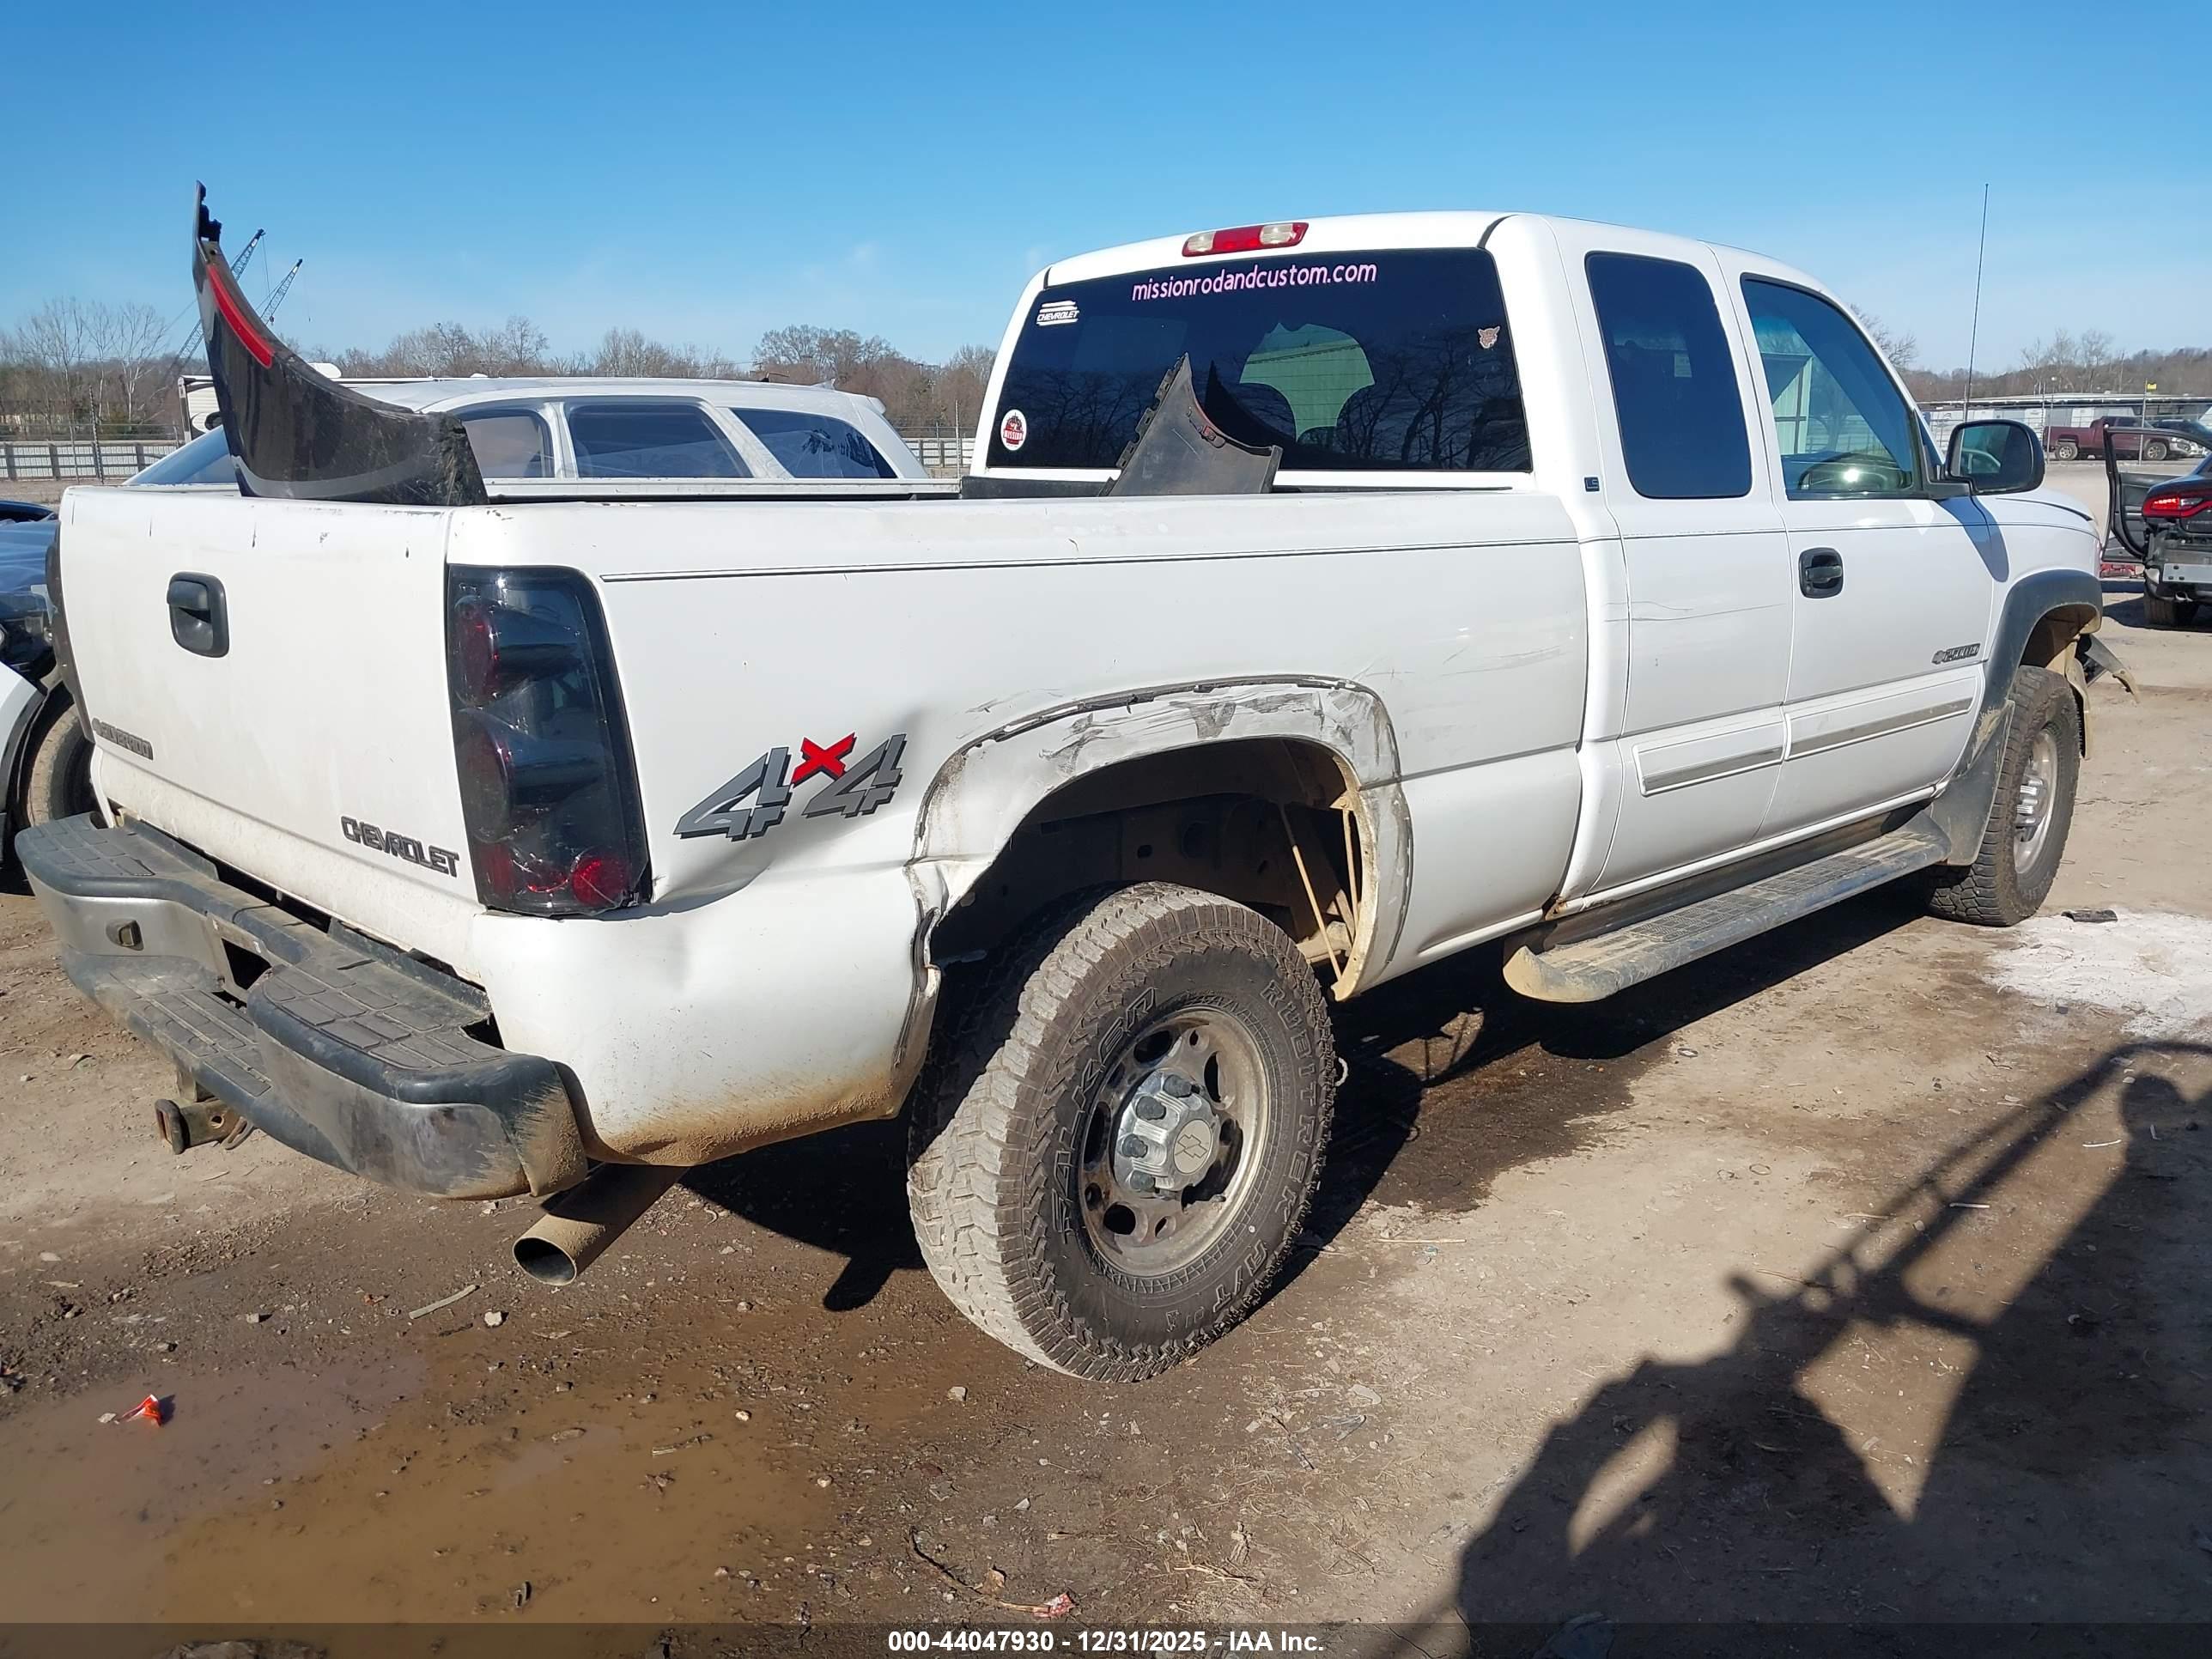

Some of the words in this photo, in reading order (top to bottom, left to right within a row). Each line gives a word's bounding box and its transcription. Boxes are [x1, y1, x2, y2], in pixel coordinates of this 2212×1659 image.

[1132, 264, 1377, 301] missionrodandcustom.com
[1036, 310, 1079, 322] CHEVROLET
[341, 816, 459, 878] CHEVROLET
[1052, 987, 1156, 1243] FALKEN
[1259, 979, 1318, 1224] RUBITREK
